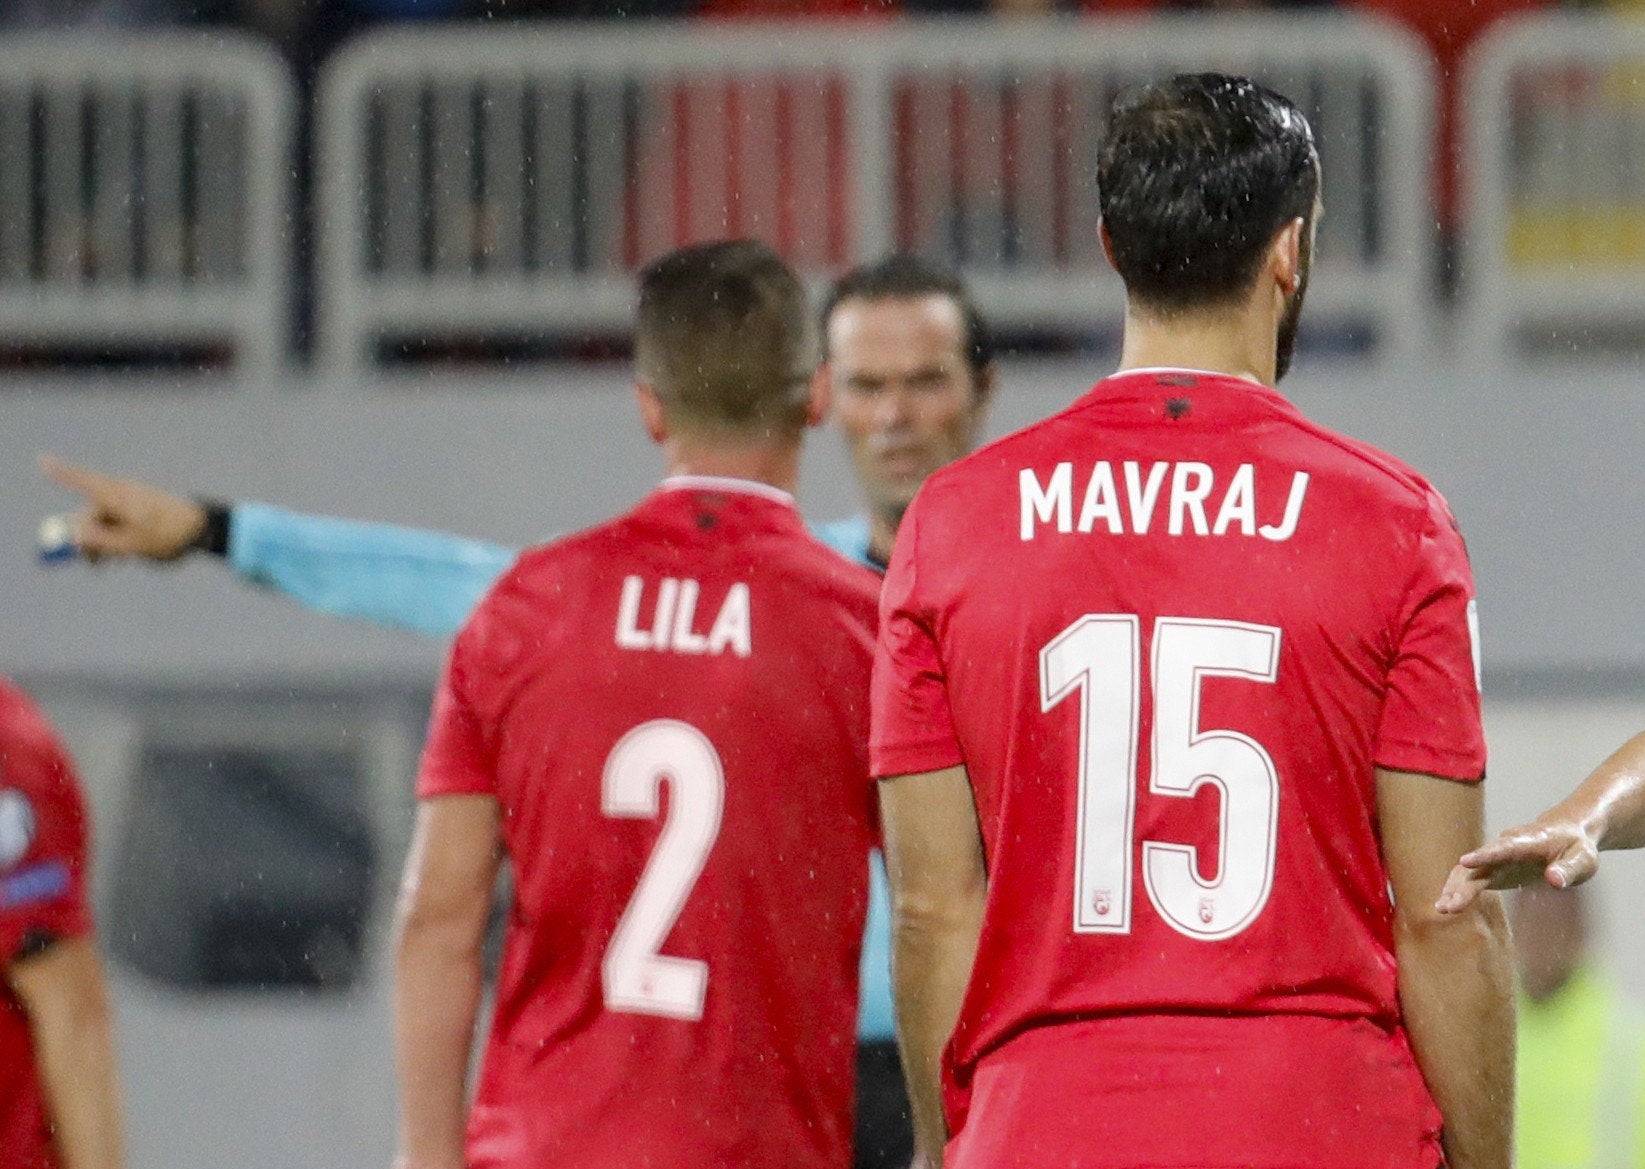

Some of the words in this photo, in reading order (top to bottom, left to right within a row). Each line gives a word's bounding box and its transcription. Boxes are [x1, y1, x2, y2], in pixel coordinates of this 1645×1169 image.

[1018, 460, 1311, 542] MAVRAJ
[614, 574, 753, 659] LILA
[601, 718, 726, 1022] 2
[1038, 613, 1283, 941] 15
